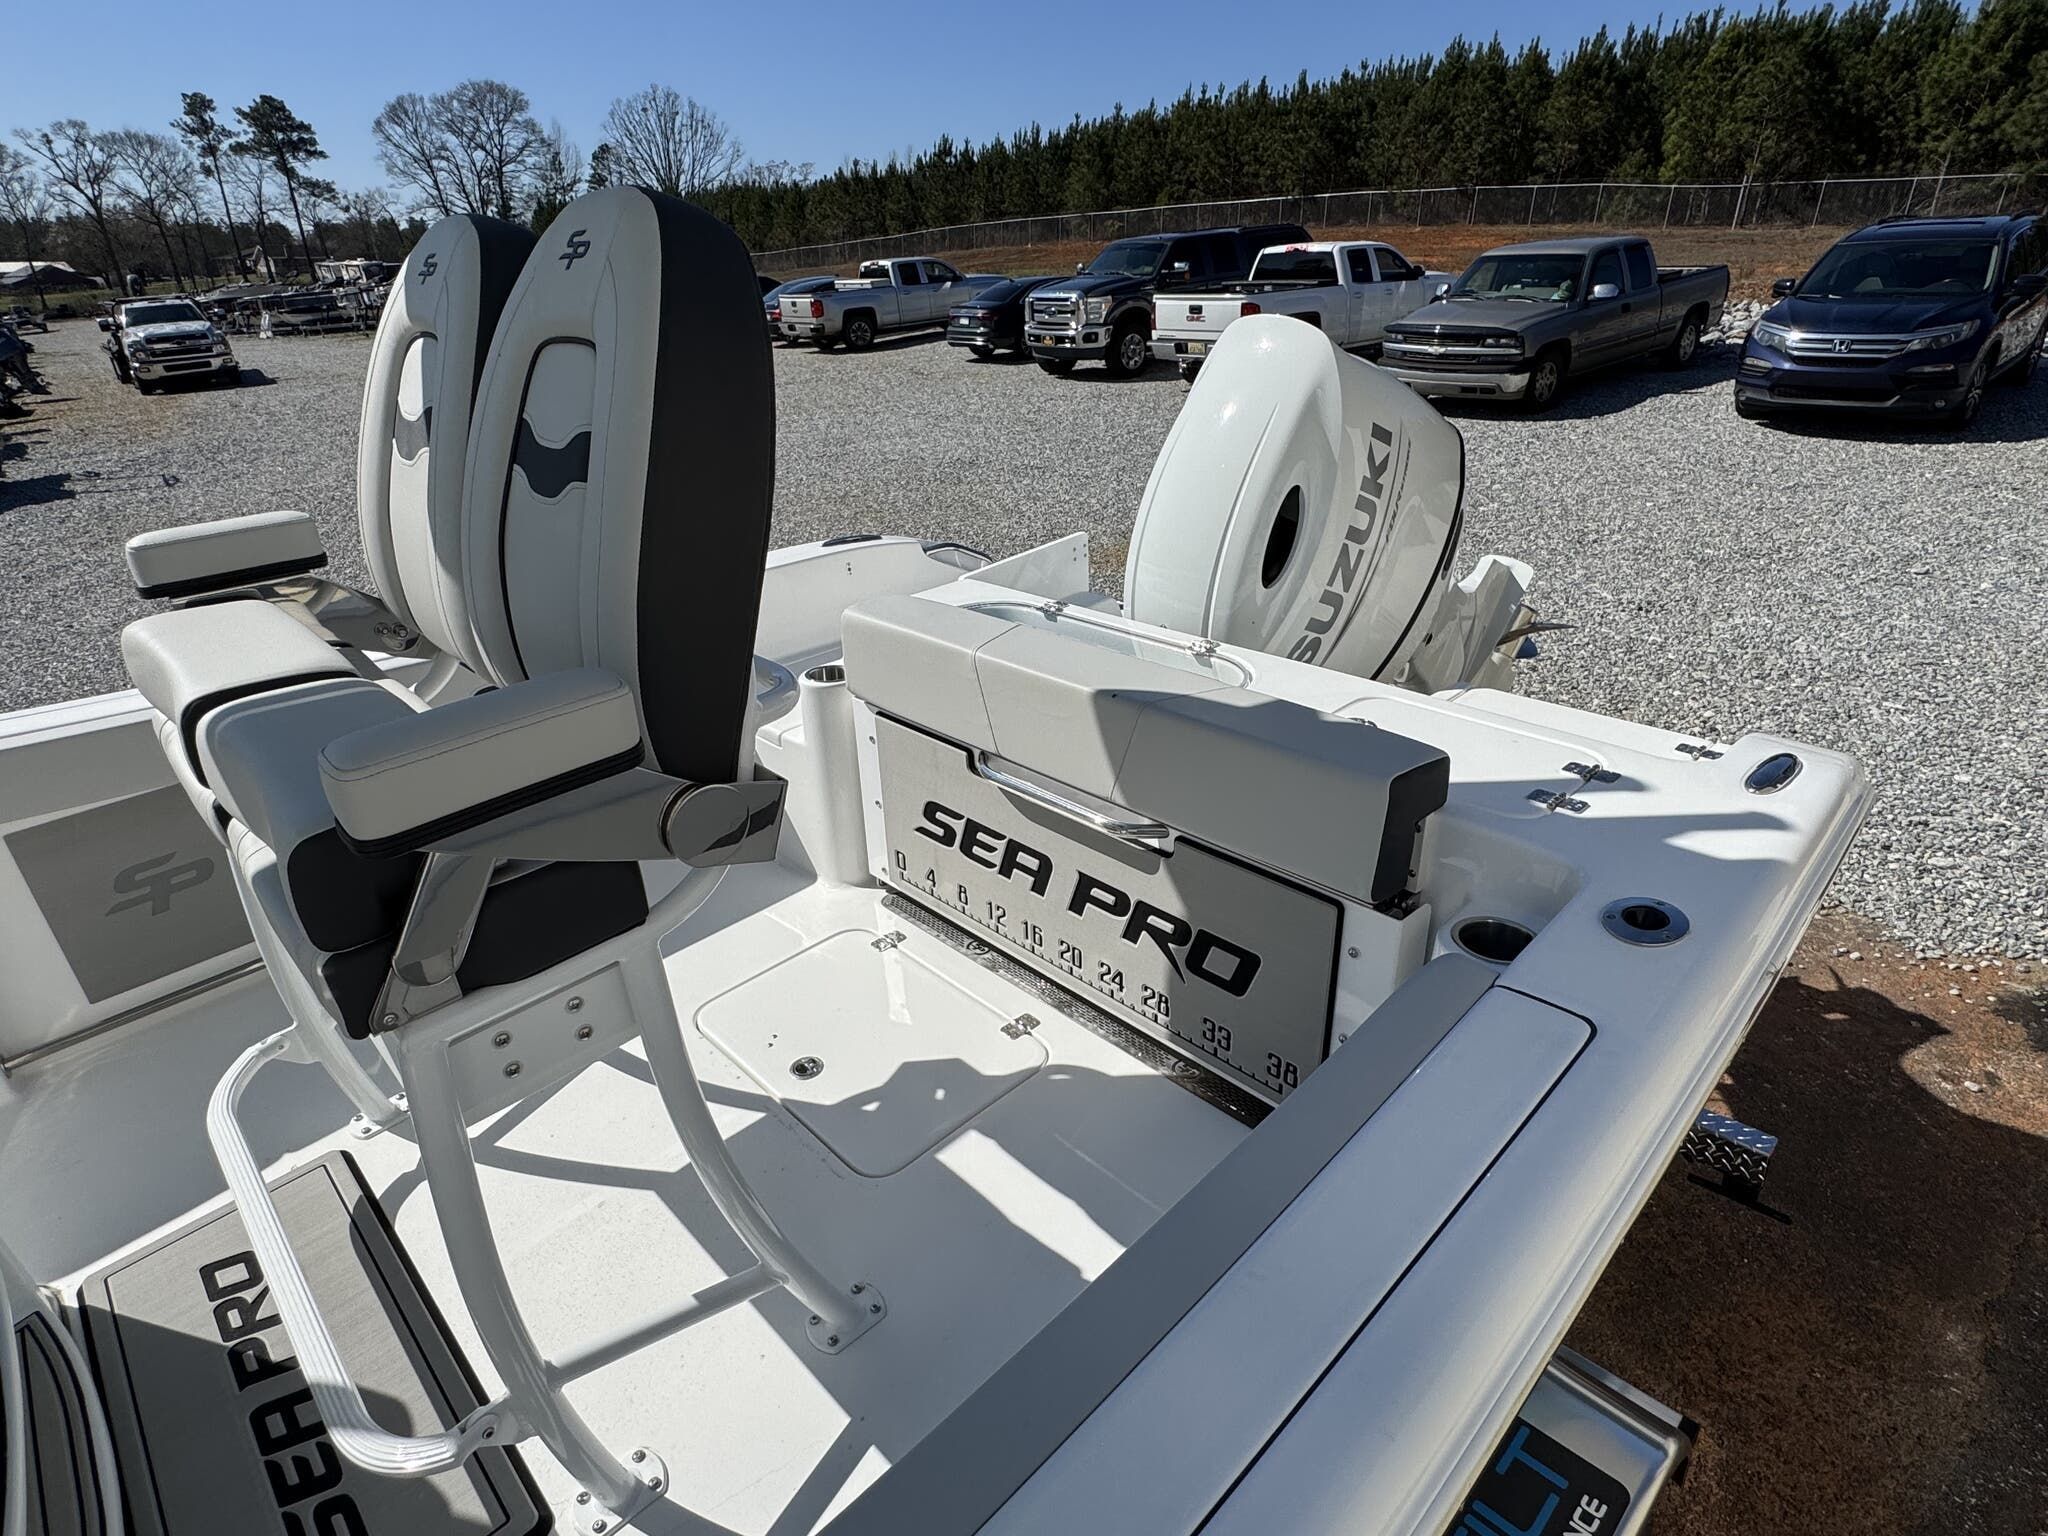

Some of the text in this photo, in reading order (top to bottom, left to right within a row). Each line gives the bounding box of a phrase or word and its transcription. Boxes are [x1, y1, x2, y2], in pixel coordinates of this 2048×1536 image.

[1286, 422, 1393, 665] SUZUKI
[914, 800, 1262, 997] SEA PRO
[926, 868, 937, 888] 4
[957, 883, 969, 906] 8
[986, 900, 1007, 928] 12
[1022, 919, 1044, 948] 16
[1058, 939, 1083, 970] 20
[1098, 959, 1125, 993] 24
[1141, 983, 1170, 1018] 28
[1203, 1016, 1233, 1053] 33
[1266, 1051, 1300, 1090] 38
[199, 1250, 369, 1536] SEA PRO
